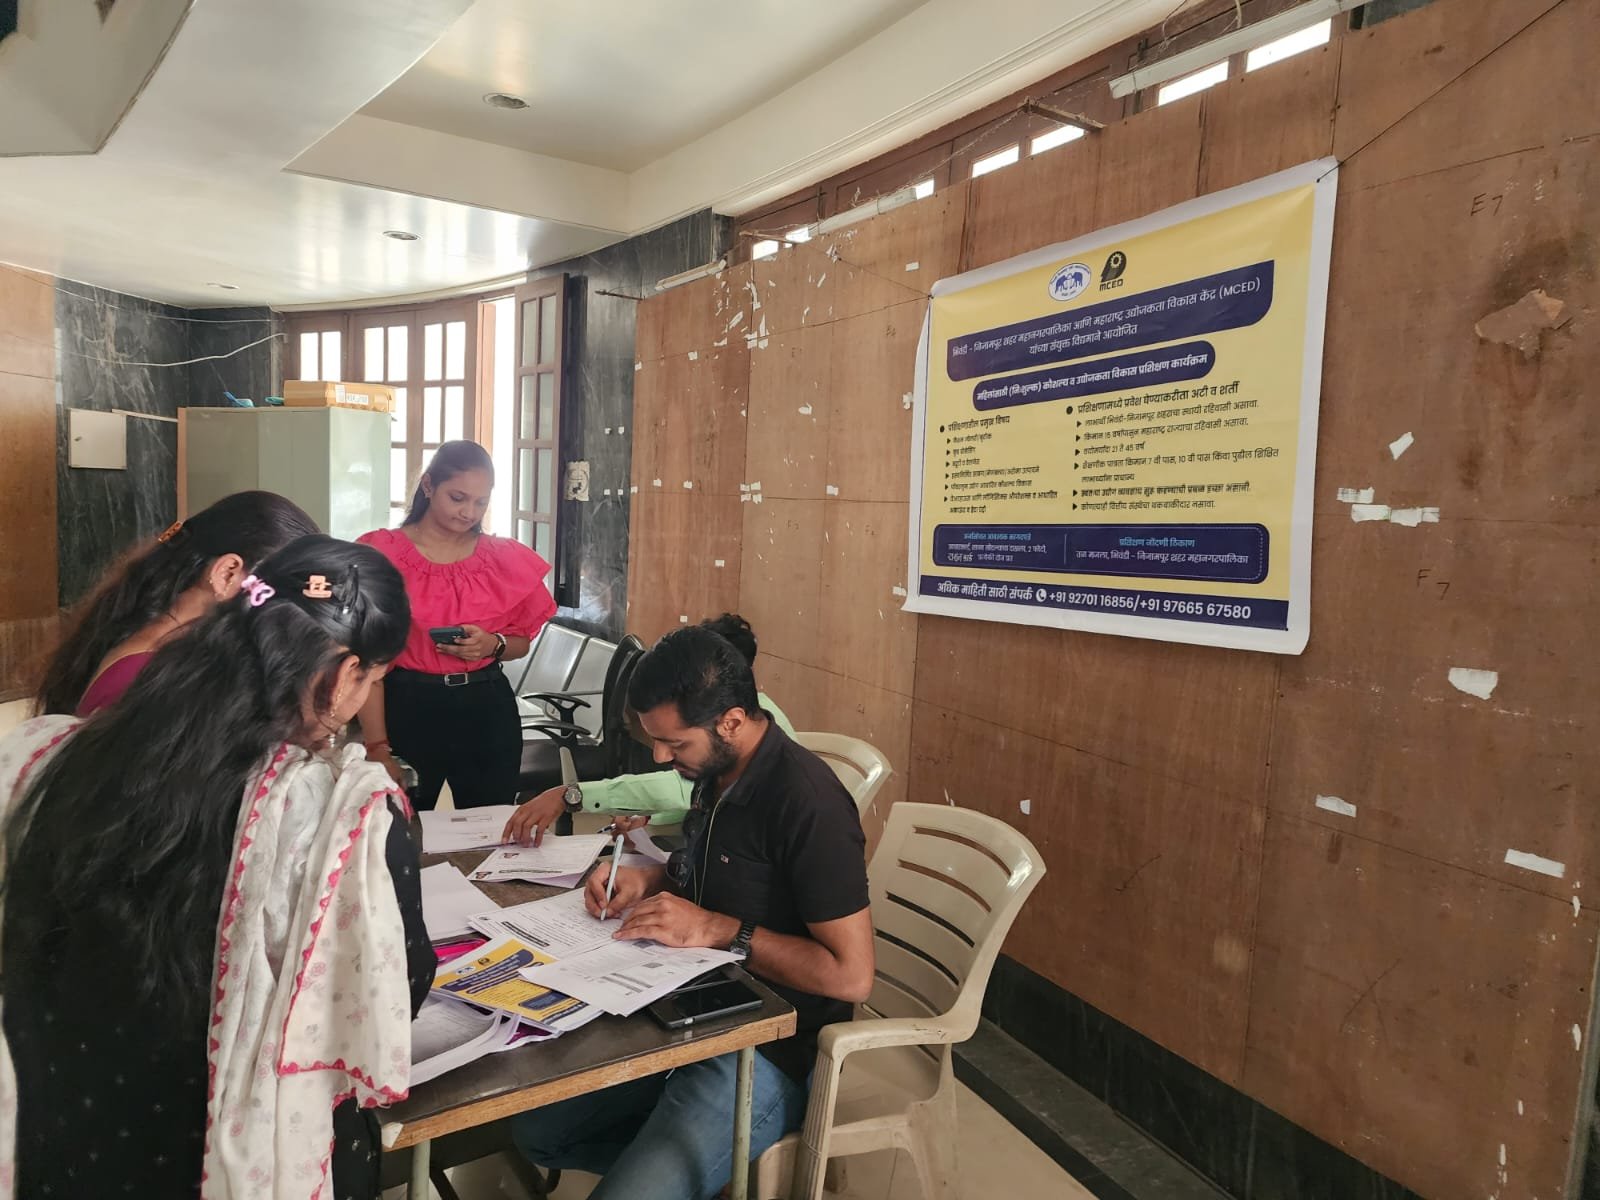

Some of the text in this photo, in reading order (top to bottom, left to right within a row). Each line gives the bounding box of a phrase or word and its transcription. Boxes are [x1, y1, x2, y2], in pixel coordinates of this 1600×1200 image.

[1099, 278, 1123, 291] MCED
[1003, 334, 1017, 345] शहर
[1018, 322, 1071, 342] महानगरपालिका
[1073, 316, 1092, 329] आणि
[1093, 310, 1123, 325] महाराष्ट्र
[1125, 301, 1164, 318] उद्योजकता
[1167, 293, 1197, 309] विकास
[1199, 289, 1216, 301] केंद्र
[1219, 277, 1260, 299] (MCED)
[1029, 323, 1137, 354] यांच्या संयुक्त विद्यमाने आयोजित
[1069, 377, 1075, 385] व
[1076, 371, 1110, 384] उद्योजकता
[1111, 366, 1137, 378] विकास
[1138, 360, 1169, 374] प्रशिक्षण
[1170, 354, 1207, 368] कार्यक्रम
[1124, 395, 1142, 407] प्रवेश
[1191, 385, 1208, 398] अटी
[1210, 386, 1217, 395] व
[1219, 380, 1240, 395] शर्ती
[937, 580, 960, 593] अधिक
[961, 582, 987, 596] माहिती
[988, 584, 1007, 598] साठी
[1009, 586, 1033, 600] संपर्क
[1049, 591, 1066, 602] +91
[1068, 592, 1097, 605] 92701
[1163, 600, 1203, 614] 97665
[1206, 603, 1251, 618] 67580
